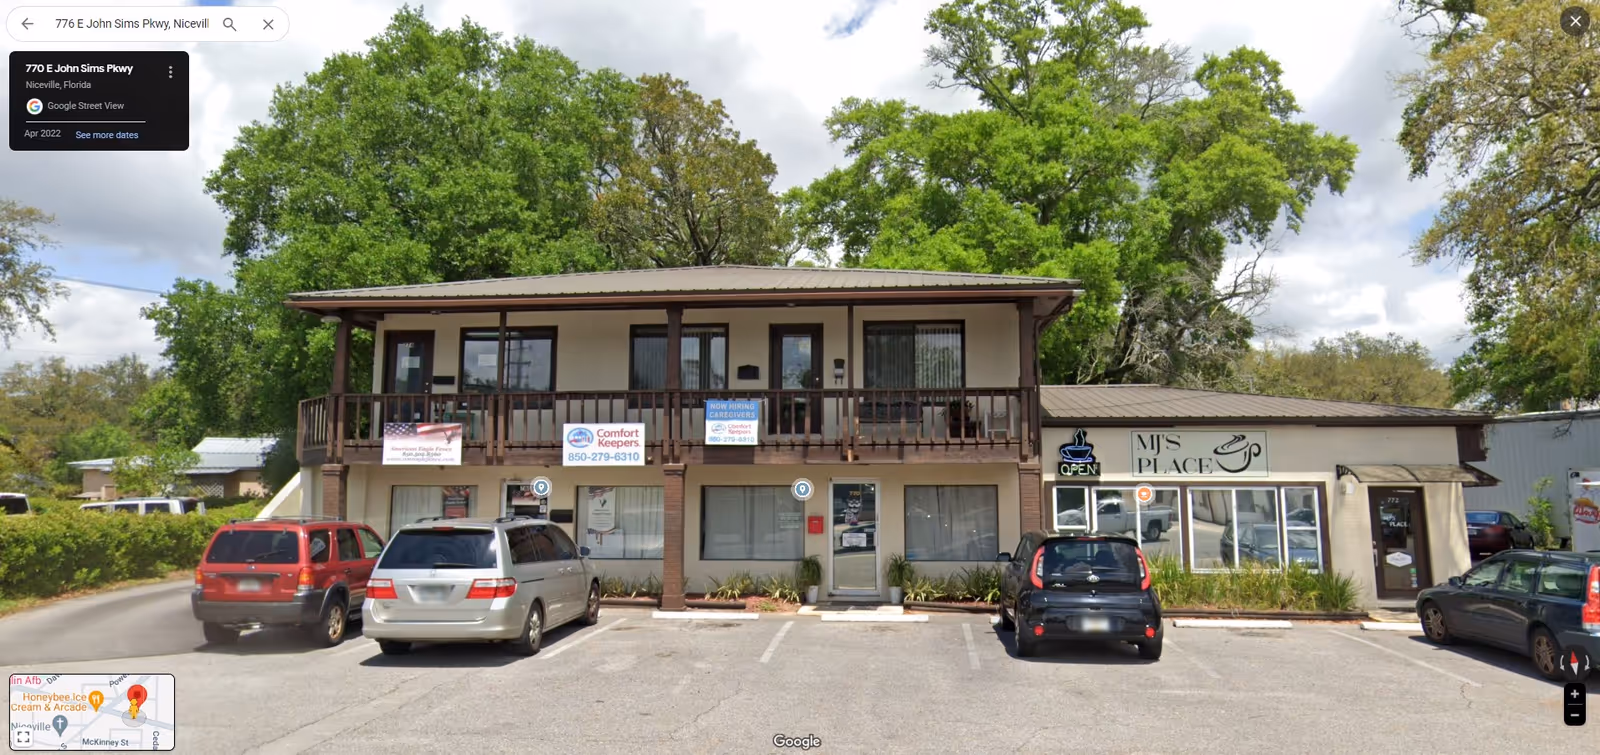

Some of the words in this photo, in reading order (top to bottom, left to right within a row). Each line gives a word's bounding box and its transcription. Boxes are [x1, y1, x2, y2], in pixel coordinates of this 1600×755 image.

[596, 428, 640, 438] Comfort
[1136, 433, 1181, 456] MJ'S
[568, 452, 640, 461] 850-279-6310
[1060, 463, 1096, 476] OPEN
[1137, 457, 1213, 475] PLACE
